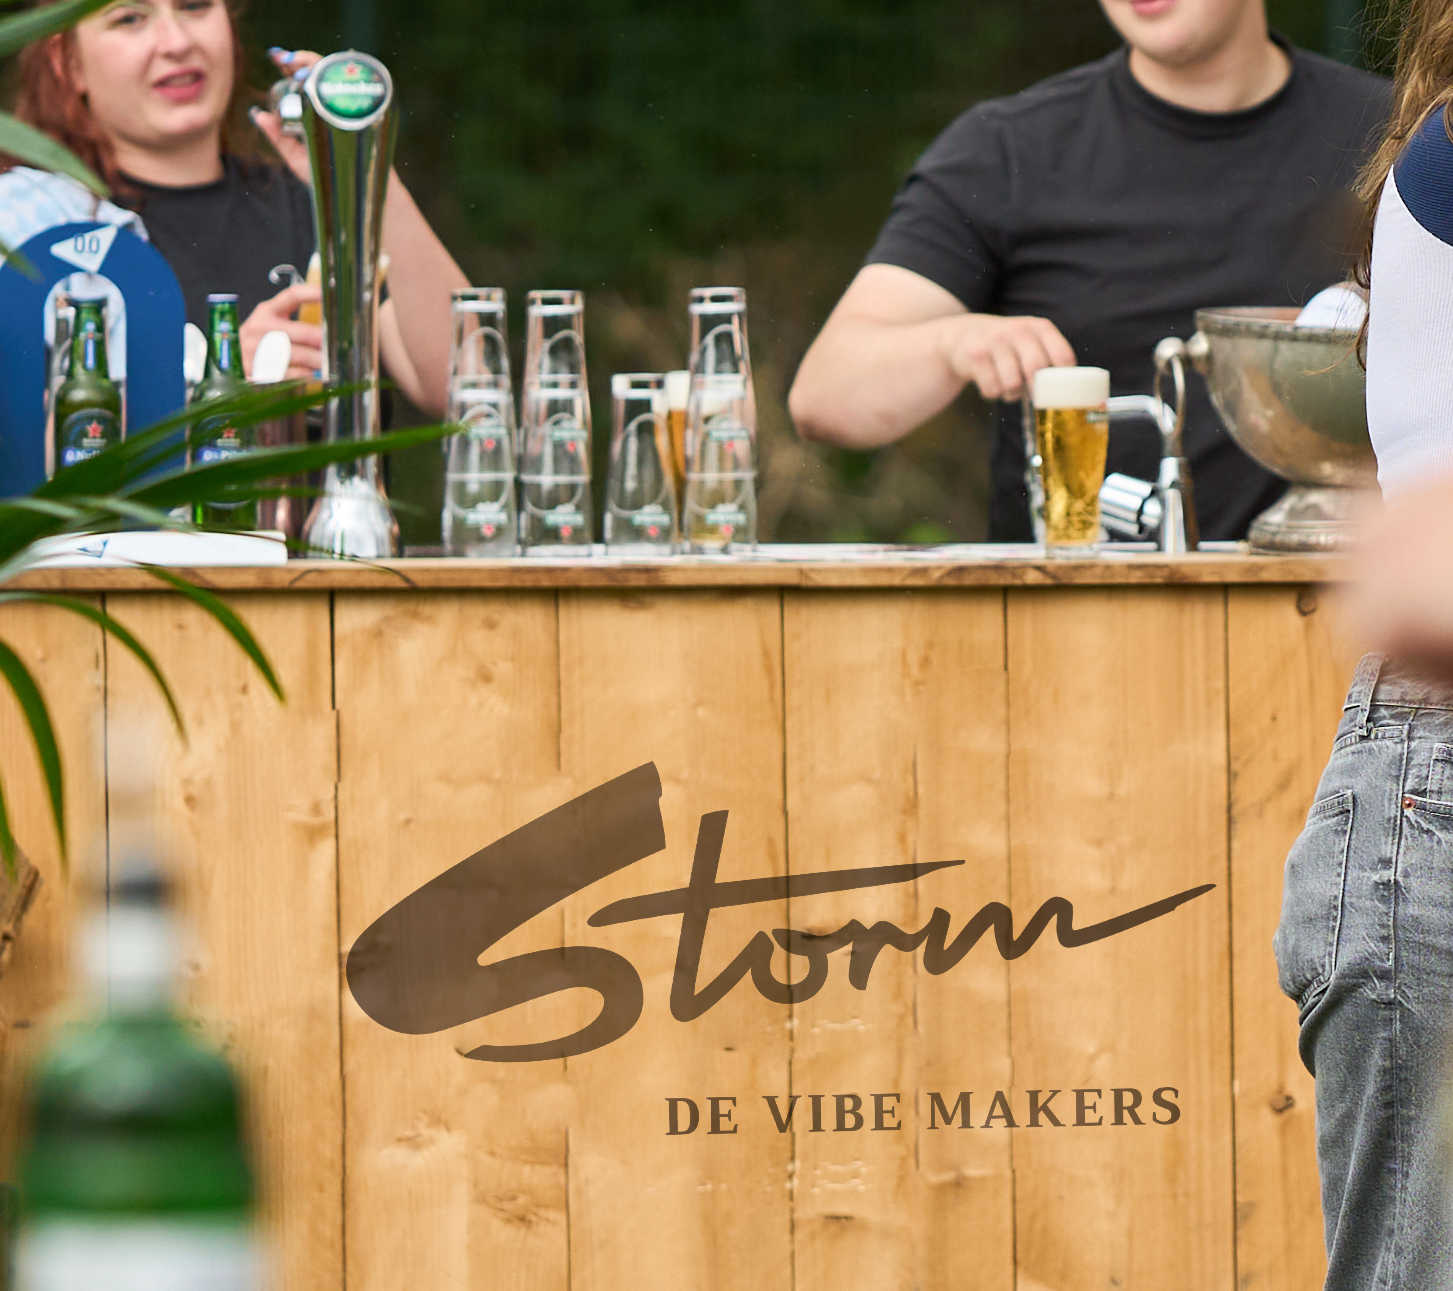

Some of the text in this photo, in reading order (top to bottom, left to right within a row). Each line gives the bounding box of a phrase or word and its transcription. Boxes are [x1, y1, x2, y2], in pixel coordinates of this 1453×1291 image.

[345, 760, 1216, 1062] Storm
[665, 1086, 1181, 1135] DE VIBE MAKERS
